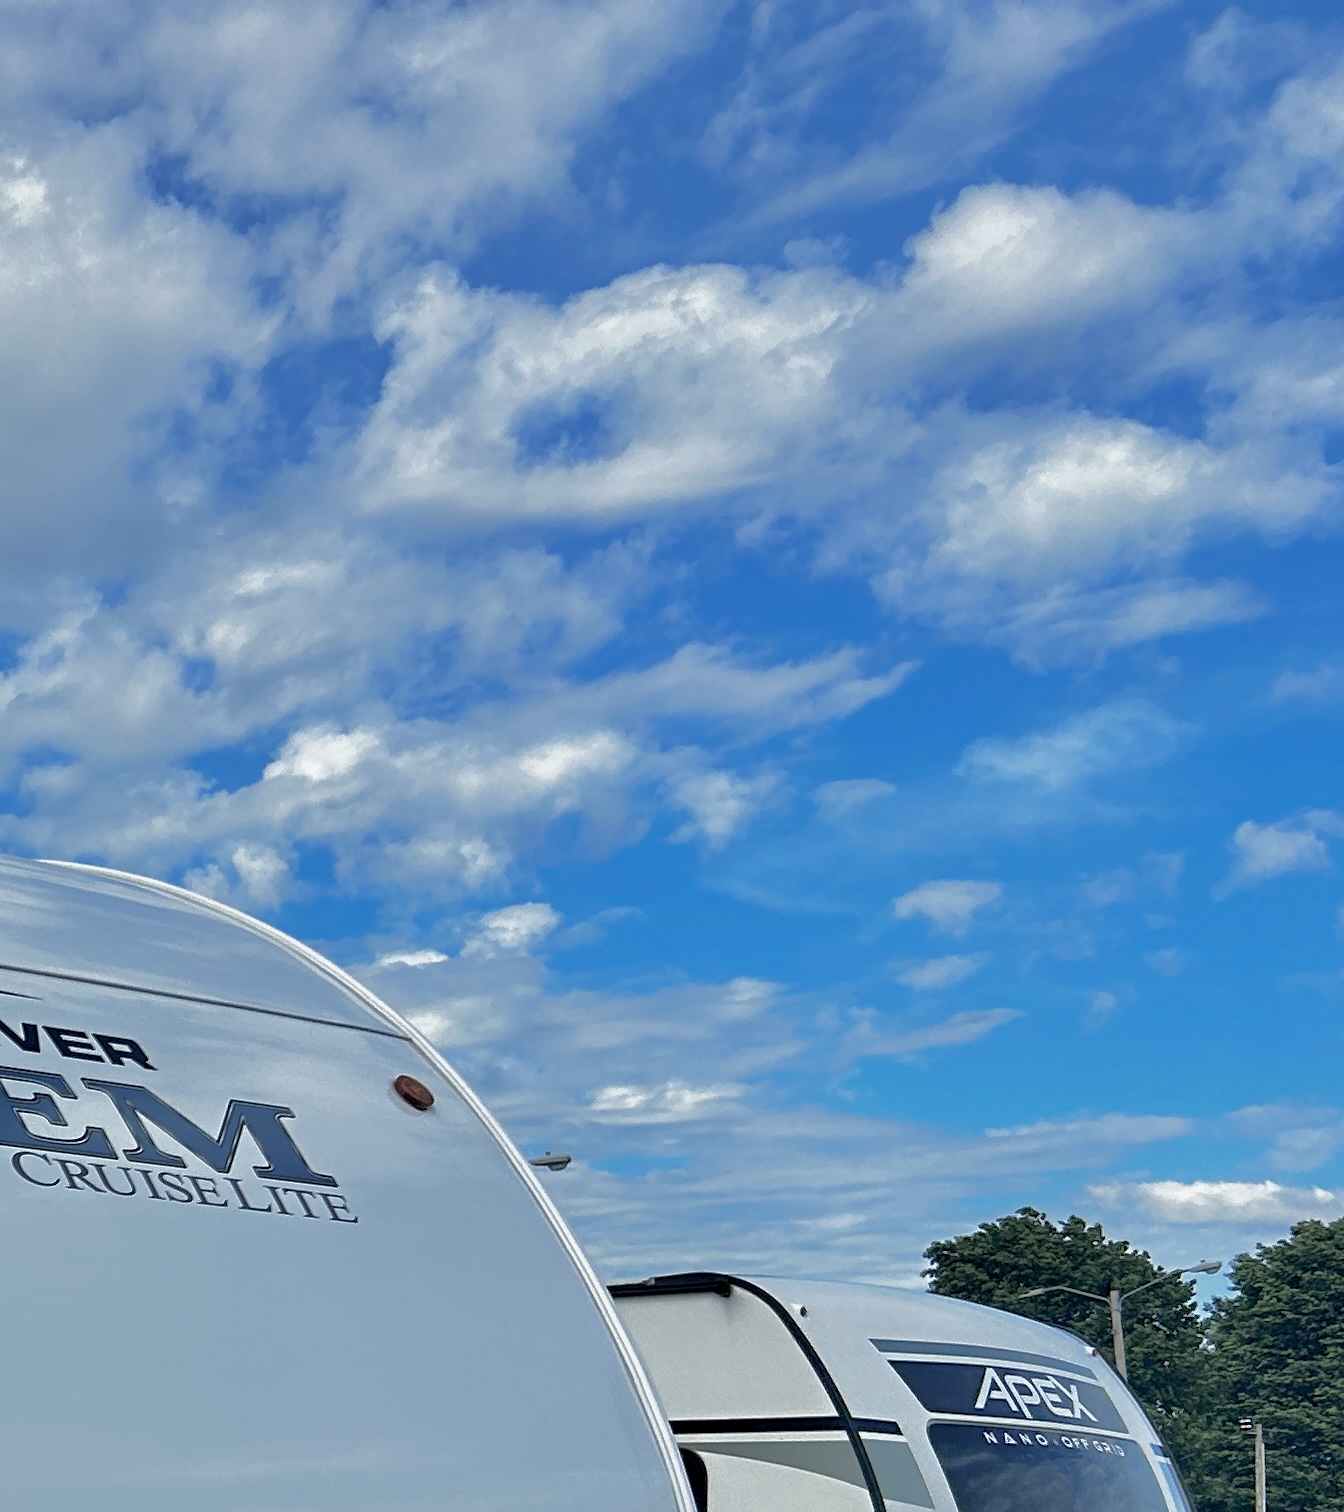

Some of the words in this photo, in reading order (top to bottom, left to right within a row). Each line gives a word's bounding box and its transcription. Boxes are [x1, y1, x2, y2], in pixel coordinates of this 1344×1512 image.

[974, 1367, 1098, 1422] APEX
[983, 1431, 1048, 1446] NANO
[1063, 1436, 1089, 1450] OFF
[1092, 1440, 1125, 1458] GRID
